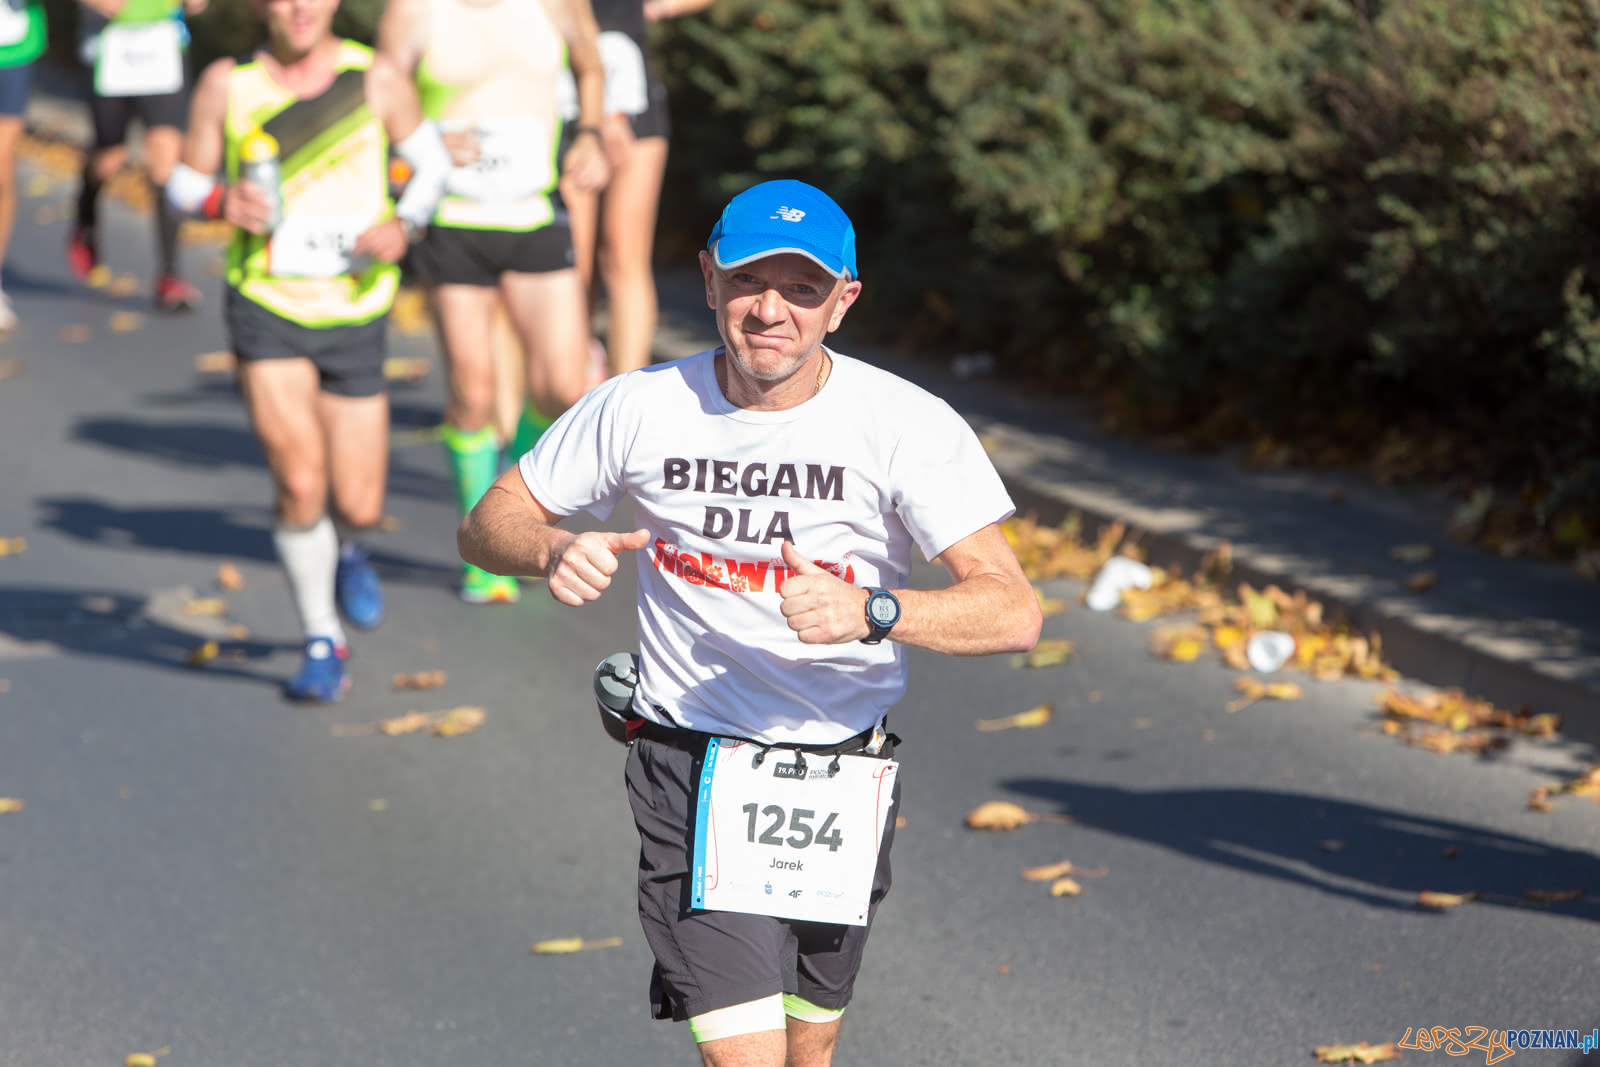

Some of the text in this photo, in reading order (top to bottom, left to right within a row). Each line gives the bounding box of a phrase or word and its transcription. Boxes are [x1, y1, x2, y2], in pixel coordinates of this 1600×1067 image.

[661, 457, 846, 501] BIEGAM
[702, 505, 796, 546] DLA
[742, 802, 844, 852] 1254
[769, 857, 804, 872] Jarek
